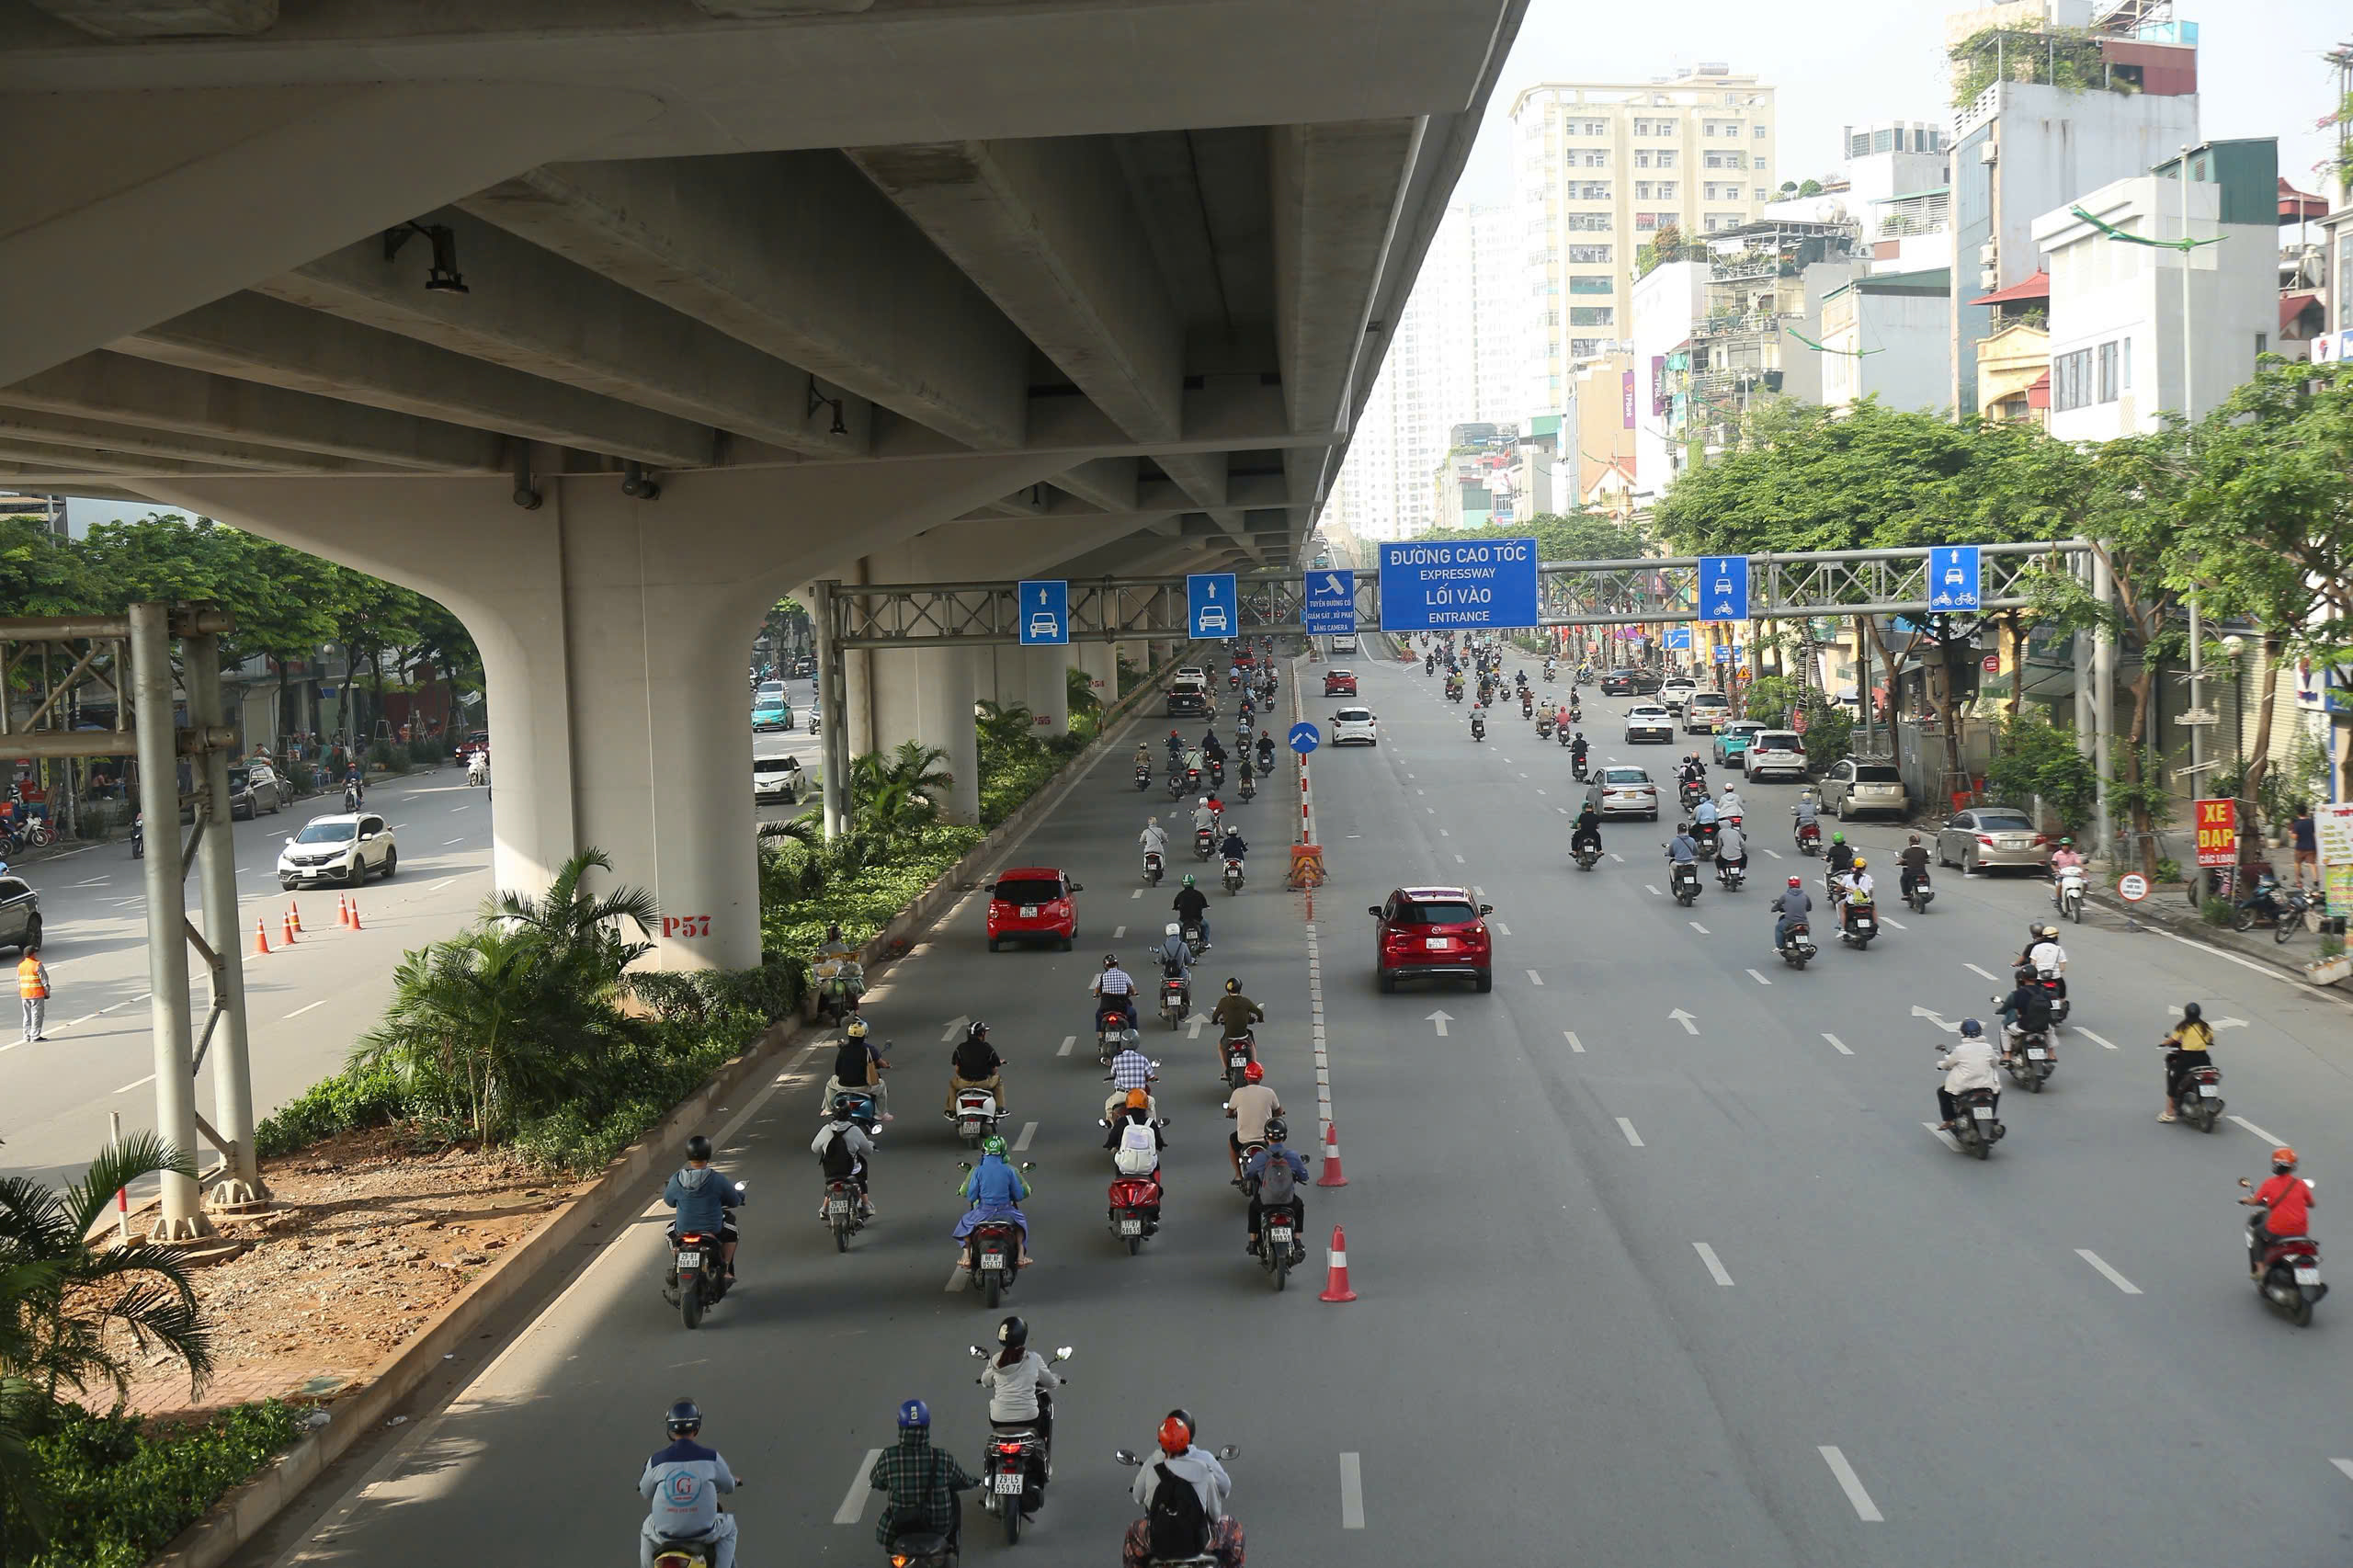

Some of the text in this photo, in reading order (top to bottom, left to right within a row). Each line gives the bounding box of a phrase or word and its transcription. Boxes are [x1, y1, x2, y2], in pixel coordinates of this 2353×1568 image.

[1625, 393, 1633, 418] TPBank
[1391, 540, 1527, 565] ĐƯỜNG CAO TỐC
[1420, 567, 1495, 580] EXPRESSWAY
[1426, 583, 1491, 606] LỐI VÀO
[1428, 610, 1490, 623] ENTRANCE
[2204, 804, 2226, 823] XE
[2198, 829, 2234, 851] ĐẠP
[662, 915, 712, 937] P57
[996, 1483, 1021, 1494] 559.76
[999, 1474, 1019, 1484] 29-L5
